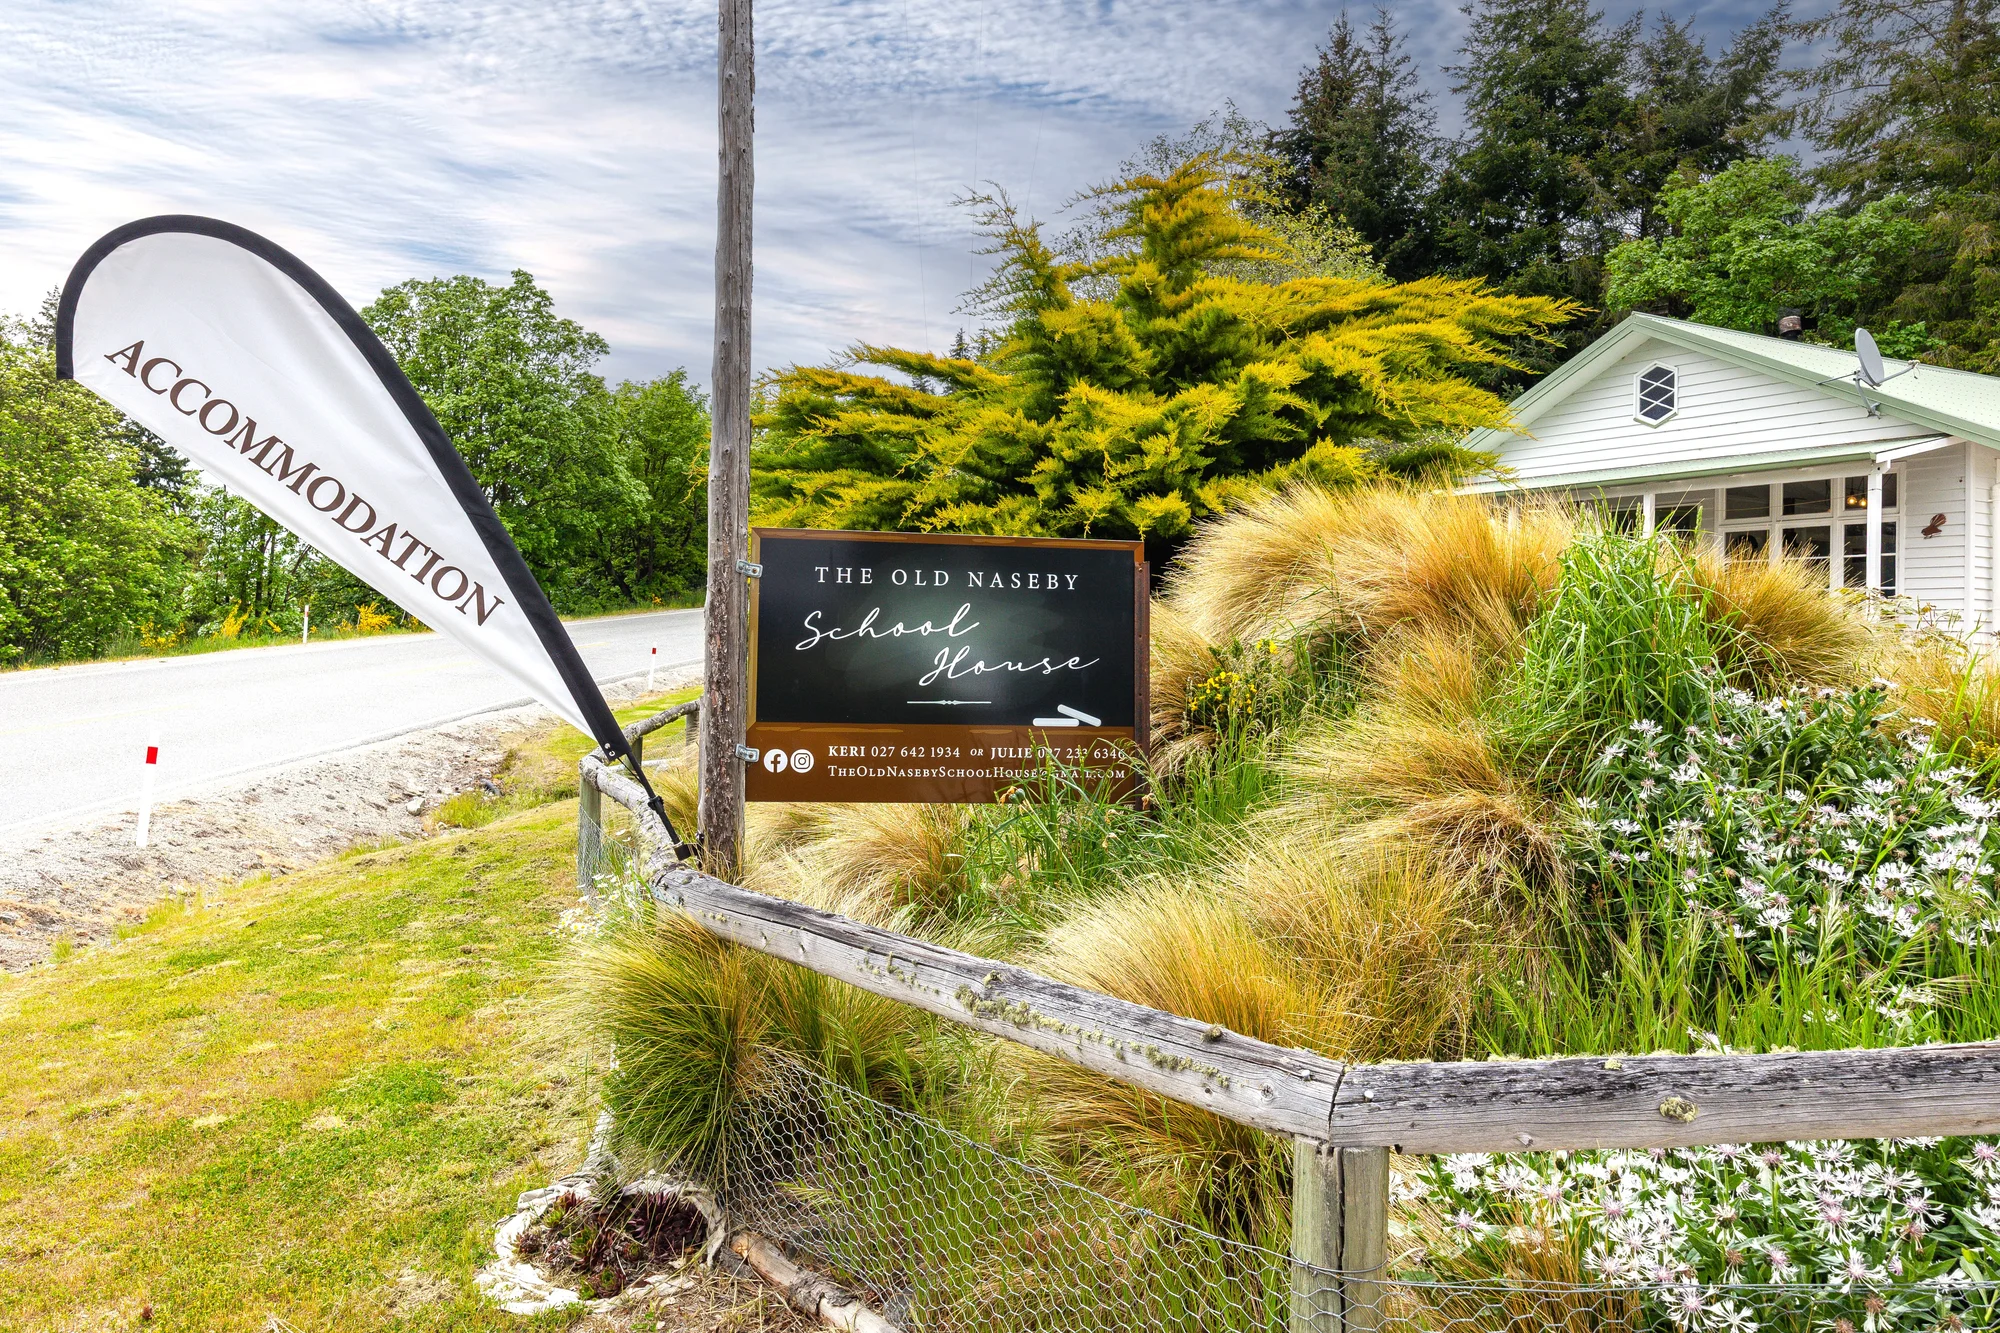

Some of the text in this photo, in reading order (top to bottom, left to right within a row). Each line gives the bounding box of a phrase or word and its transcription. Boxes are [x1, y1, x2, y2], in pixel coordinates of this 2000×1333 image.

[104, 338, 505, 628] ACCOMMODATION
[814, 566, 1079, 590] THE OLD NASEBY
[795, 602, 980, 651] School
[918, 645, 1100, 687] House
[828, 745, 866, 757] KERI
[871, 746, 896, 758] 027
[900, 746, 926, 758] 642
[930, 746, 961, 758] 1934
[990, 747, 1033, 760] JULIE
